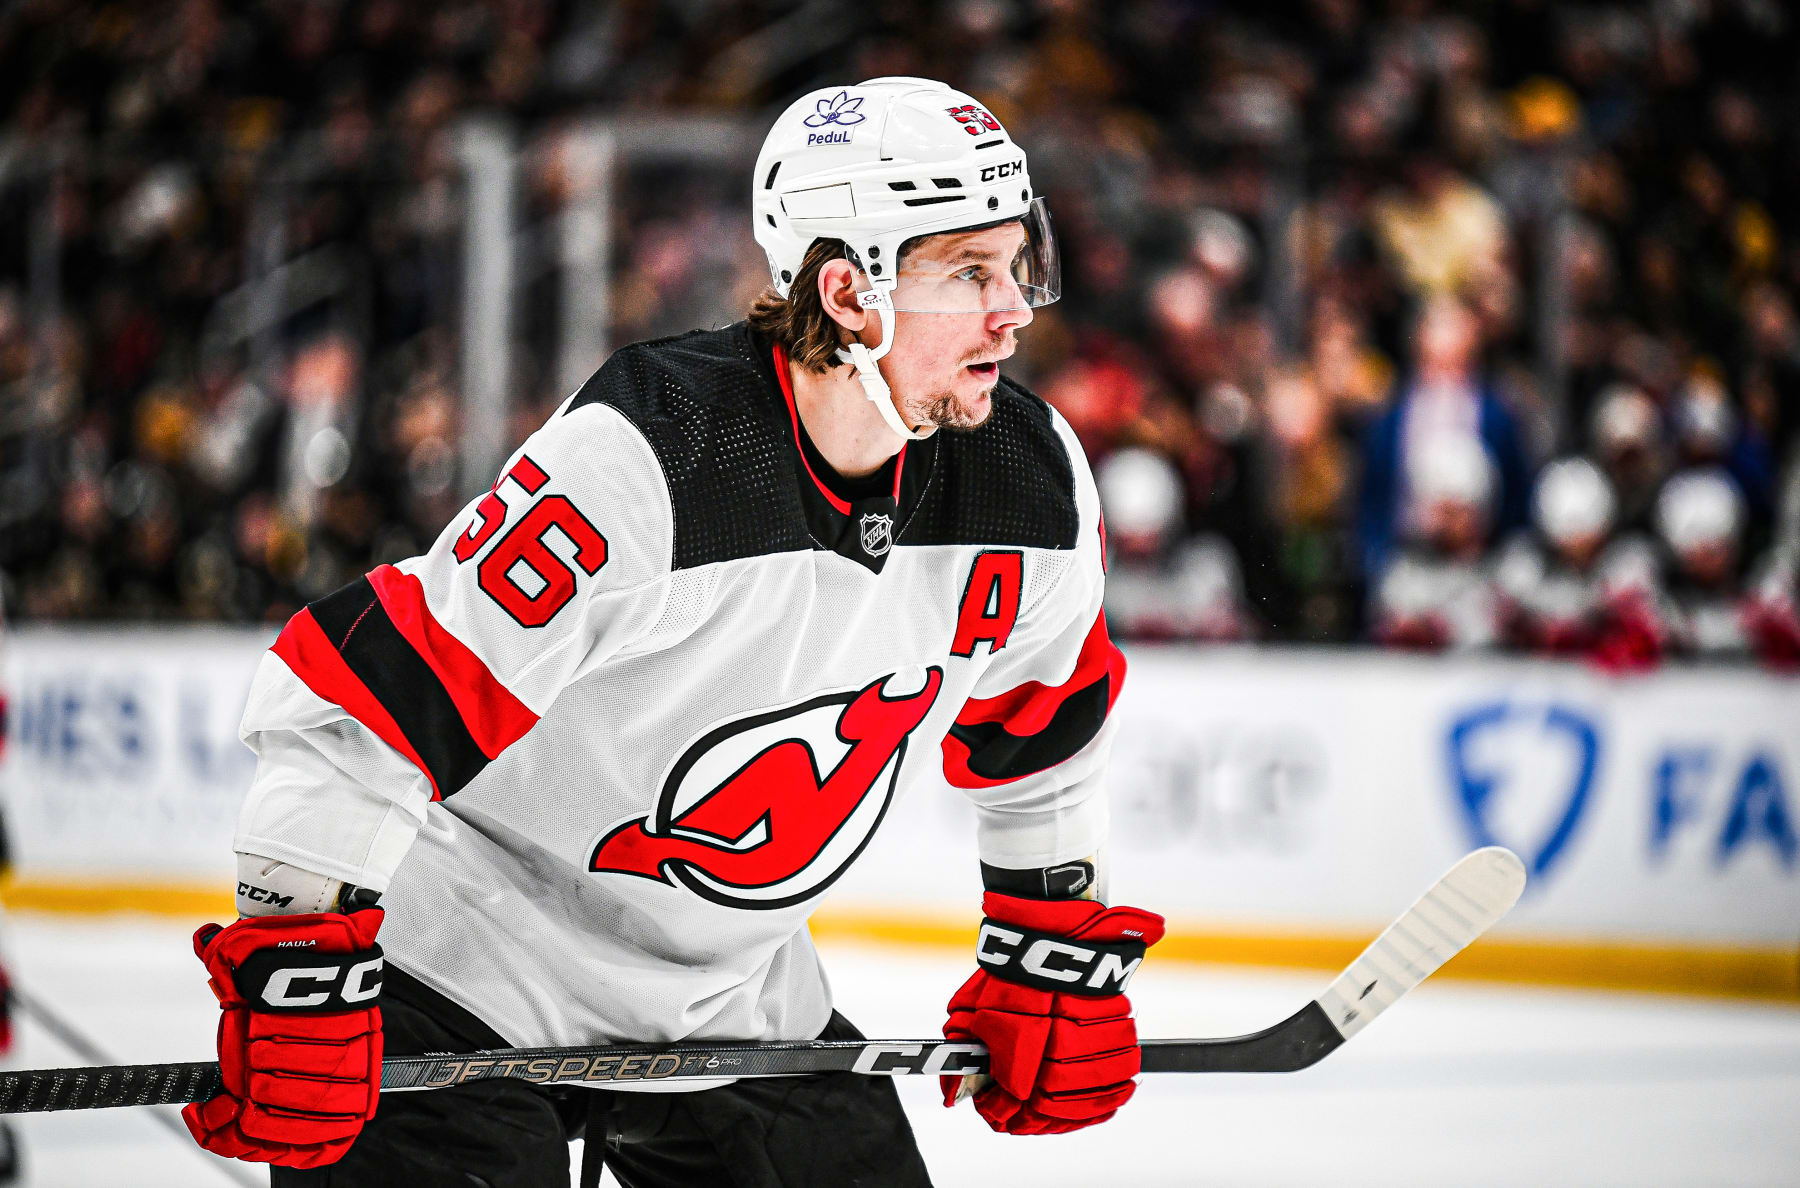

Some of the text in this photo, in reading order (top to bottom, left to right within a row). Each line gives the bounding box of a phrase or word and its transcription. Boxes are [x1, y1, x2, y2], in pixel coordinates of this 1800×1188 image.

[980, 160, 1022, 182] CCM
[452, 454, 608, 628] 56
[867, 524, 886, 547] NHL
[950, 550, 1024, 657] A
[237, 881, 294, 908] CCM
[277, 939, 316, 948] HAULA
[976, 924, 1143, 989] CCM
